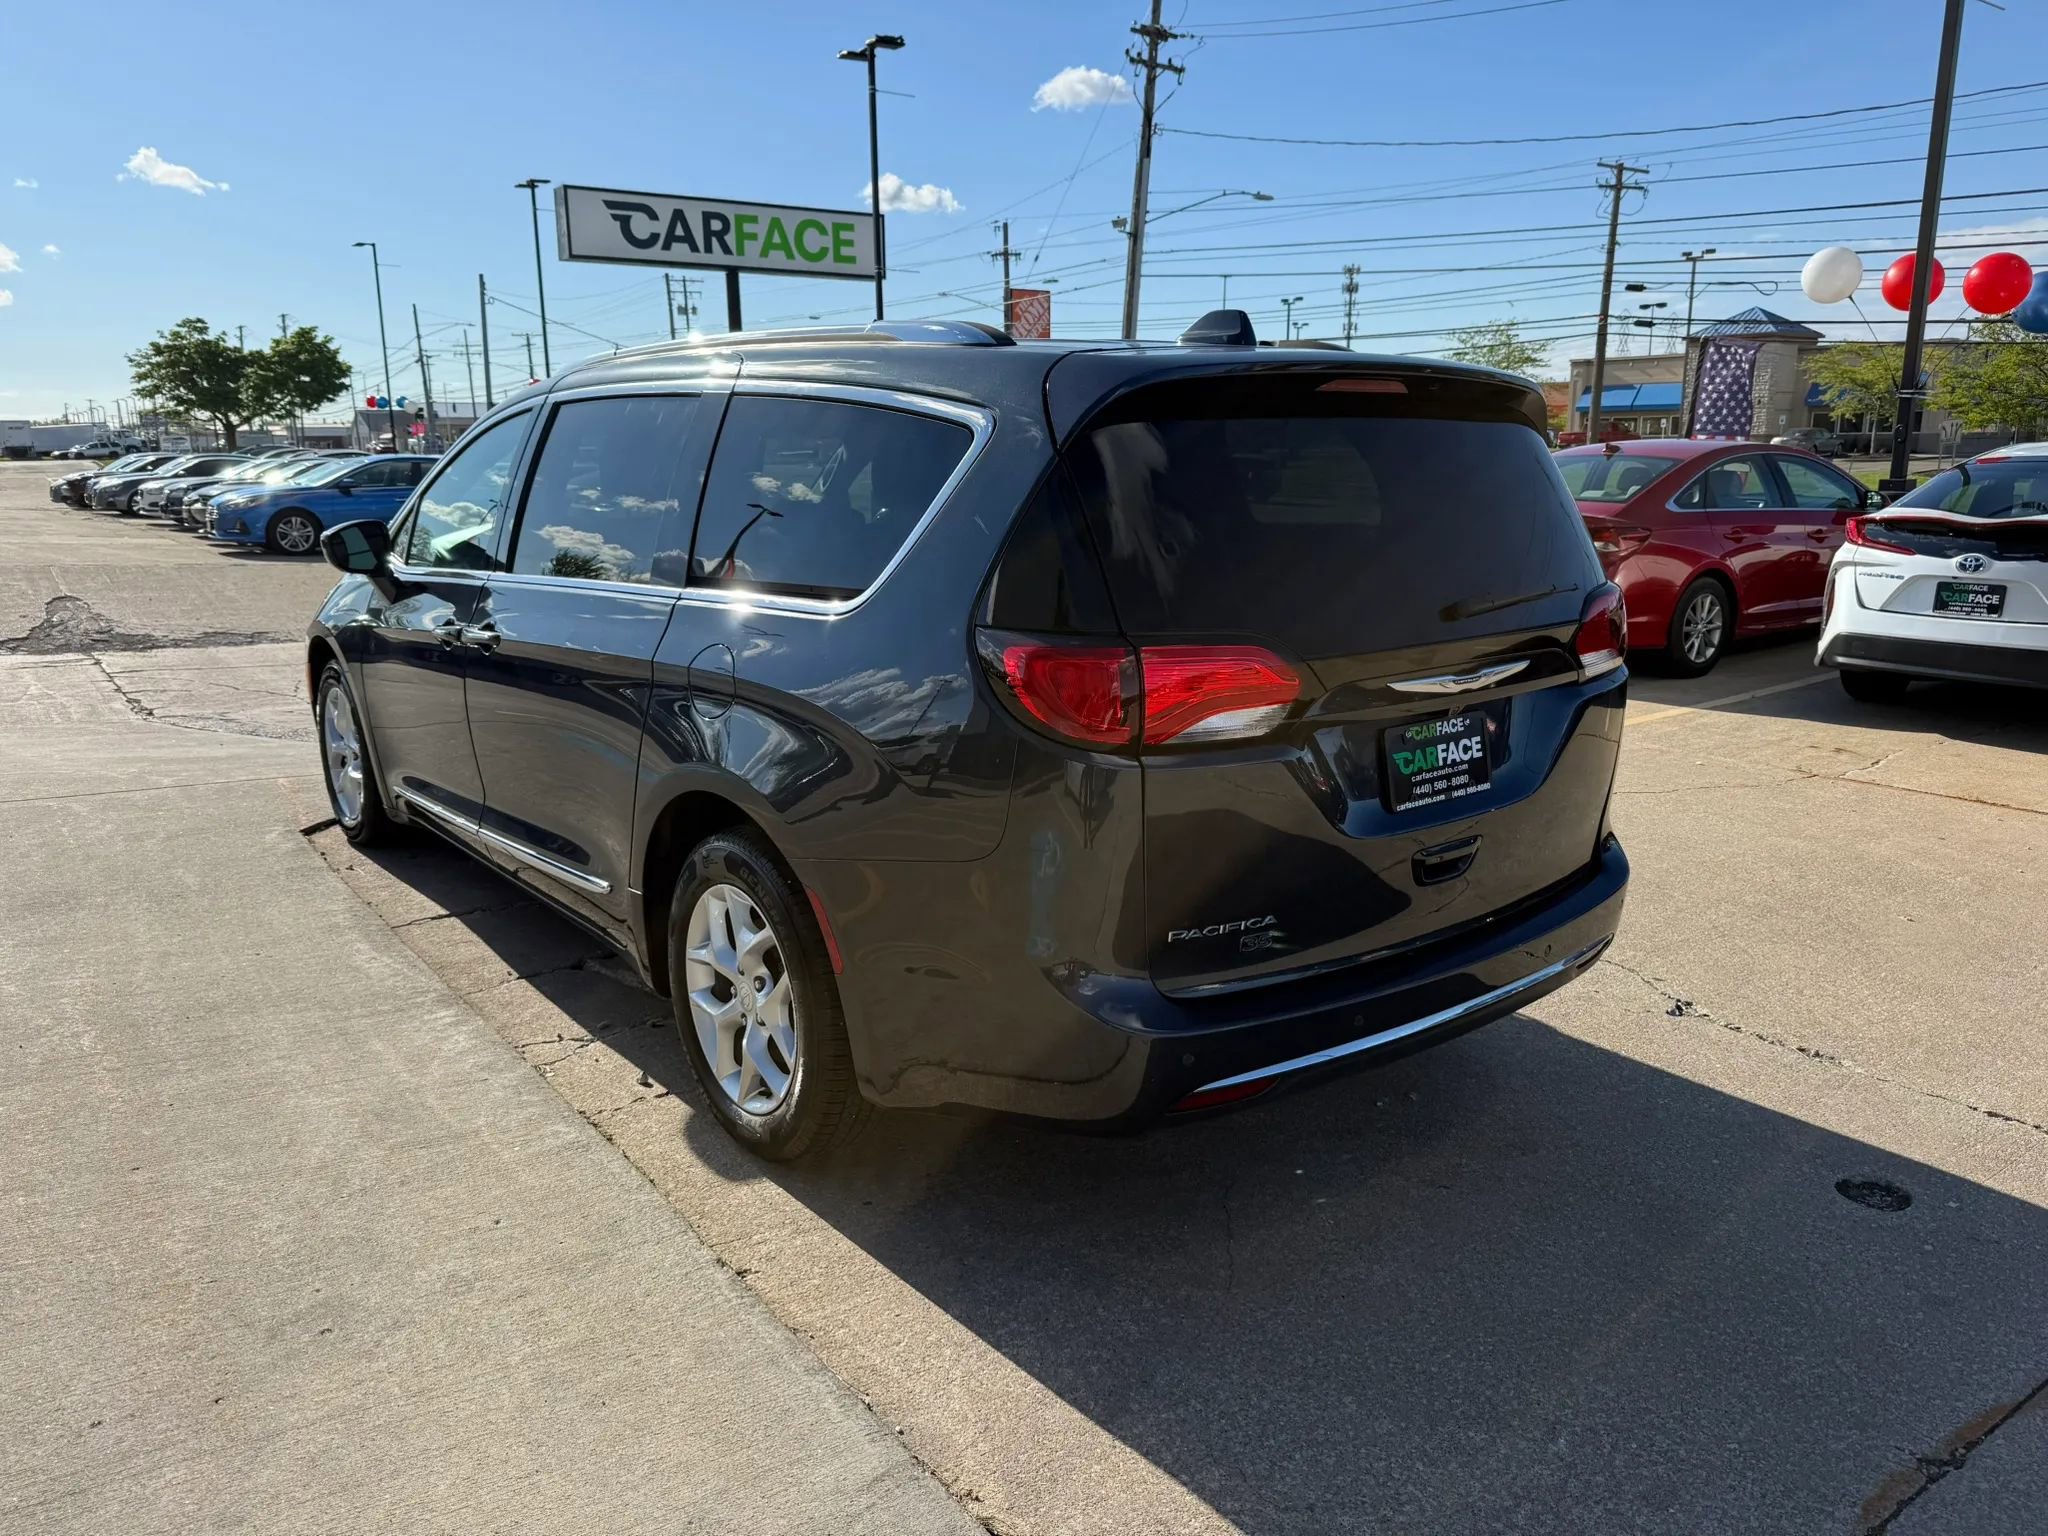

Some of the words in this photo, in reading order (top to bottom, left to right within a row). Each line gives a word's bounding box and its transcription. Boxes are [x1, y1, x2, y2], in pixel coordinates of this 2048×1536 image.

[601, 199, 857, 265] CARFACE
[1940, 591, 2001, 605] CARFACE
[1952, 583, 1989, 592] CARFACE
[1409, 717, 1465, 741] CARFACE
[1391, 735, 1483, 775] CARFACE
[1411, 763, 1469, 782] carfaceauto.com
[1396, 794, 1446, 811] carfaceauto.com
[1451, 789, 1466, 799] (440)
[1412, 783, 1433, 795] (440)
[1167, 915, 1279, 943] PACIFICA
